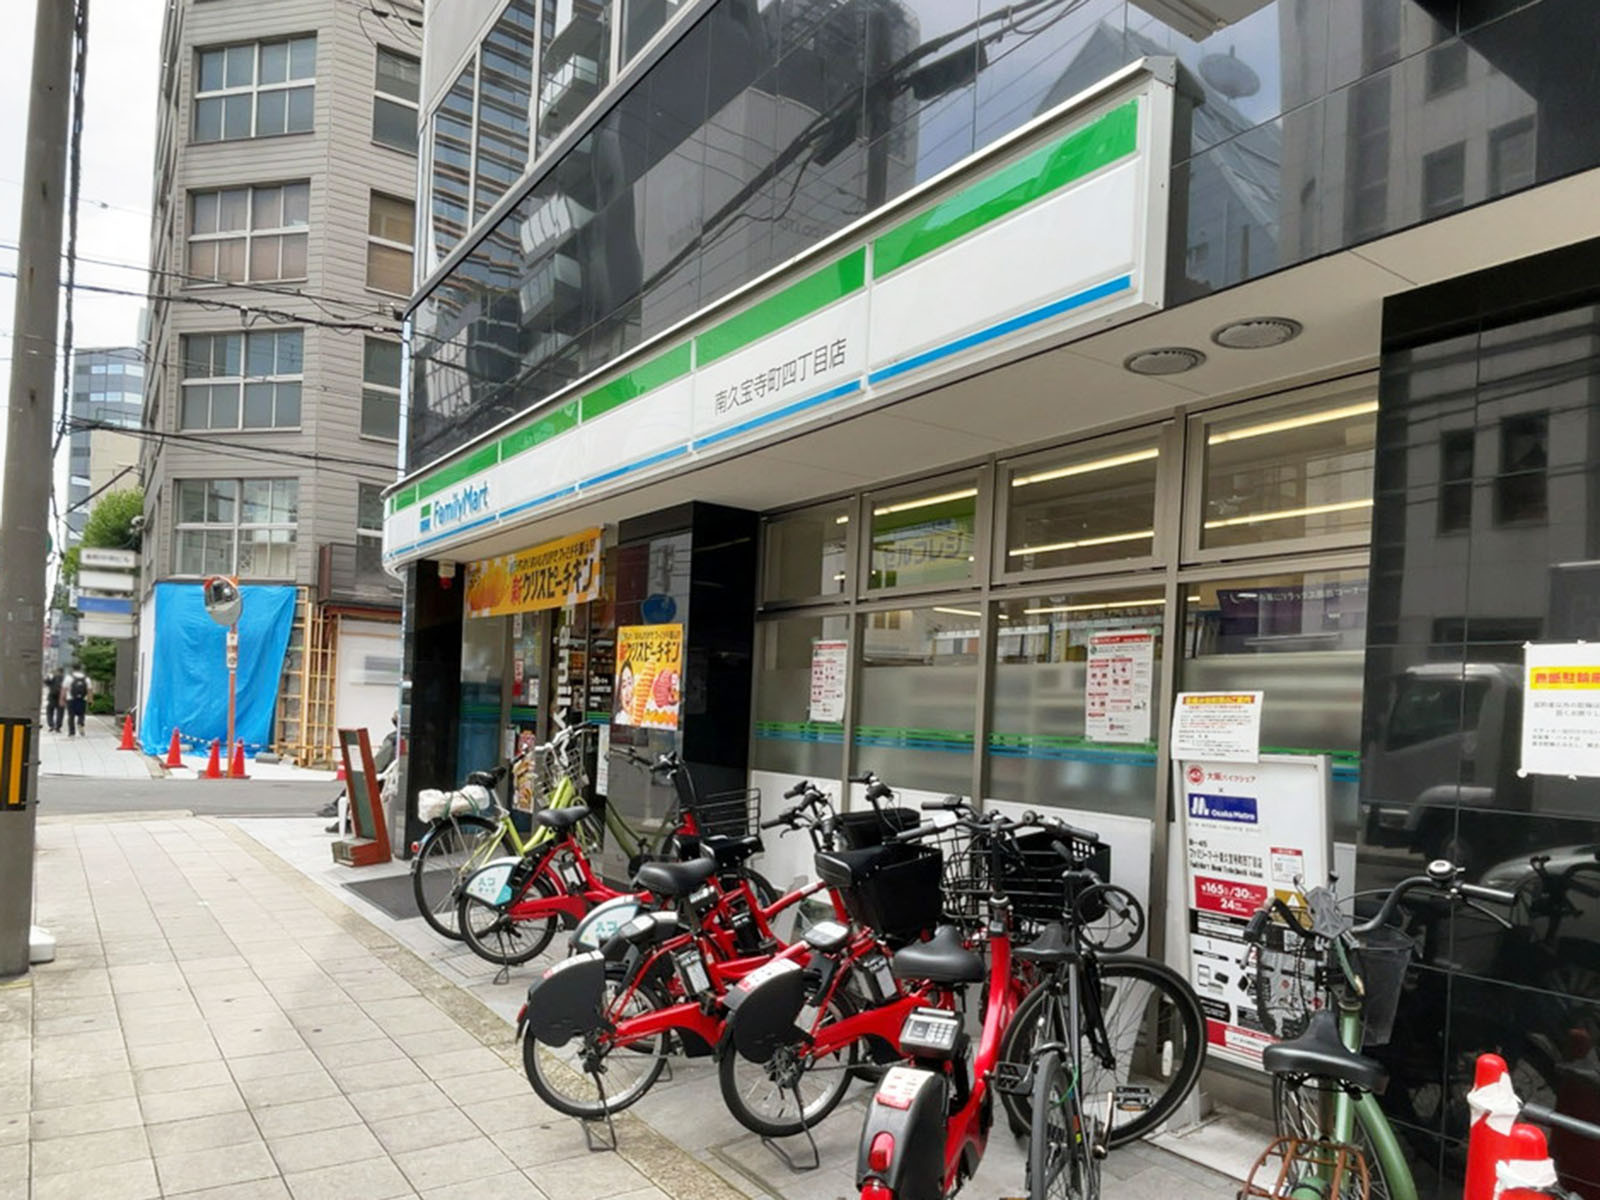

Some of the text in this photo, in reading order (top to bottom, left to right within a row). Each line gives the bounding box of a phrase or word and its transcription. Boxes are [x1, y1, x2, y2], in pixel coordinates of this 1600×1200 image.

[714, 338, 847, 415] 南久宝寺町四丁目店
[434, 480, 489, 528] FamilyMart
